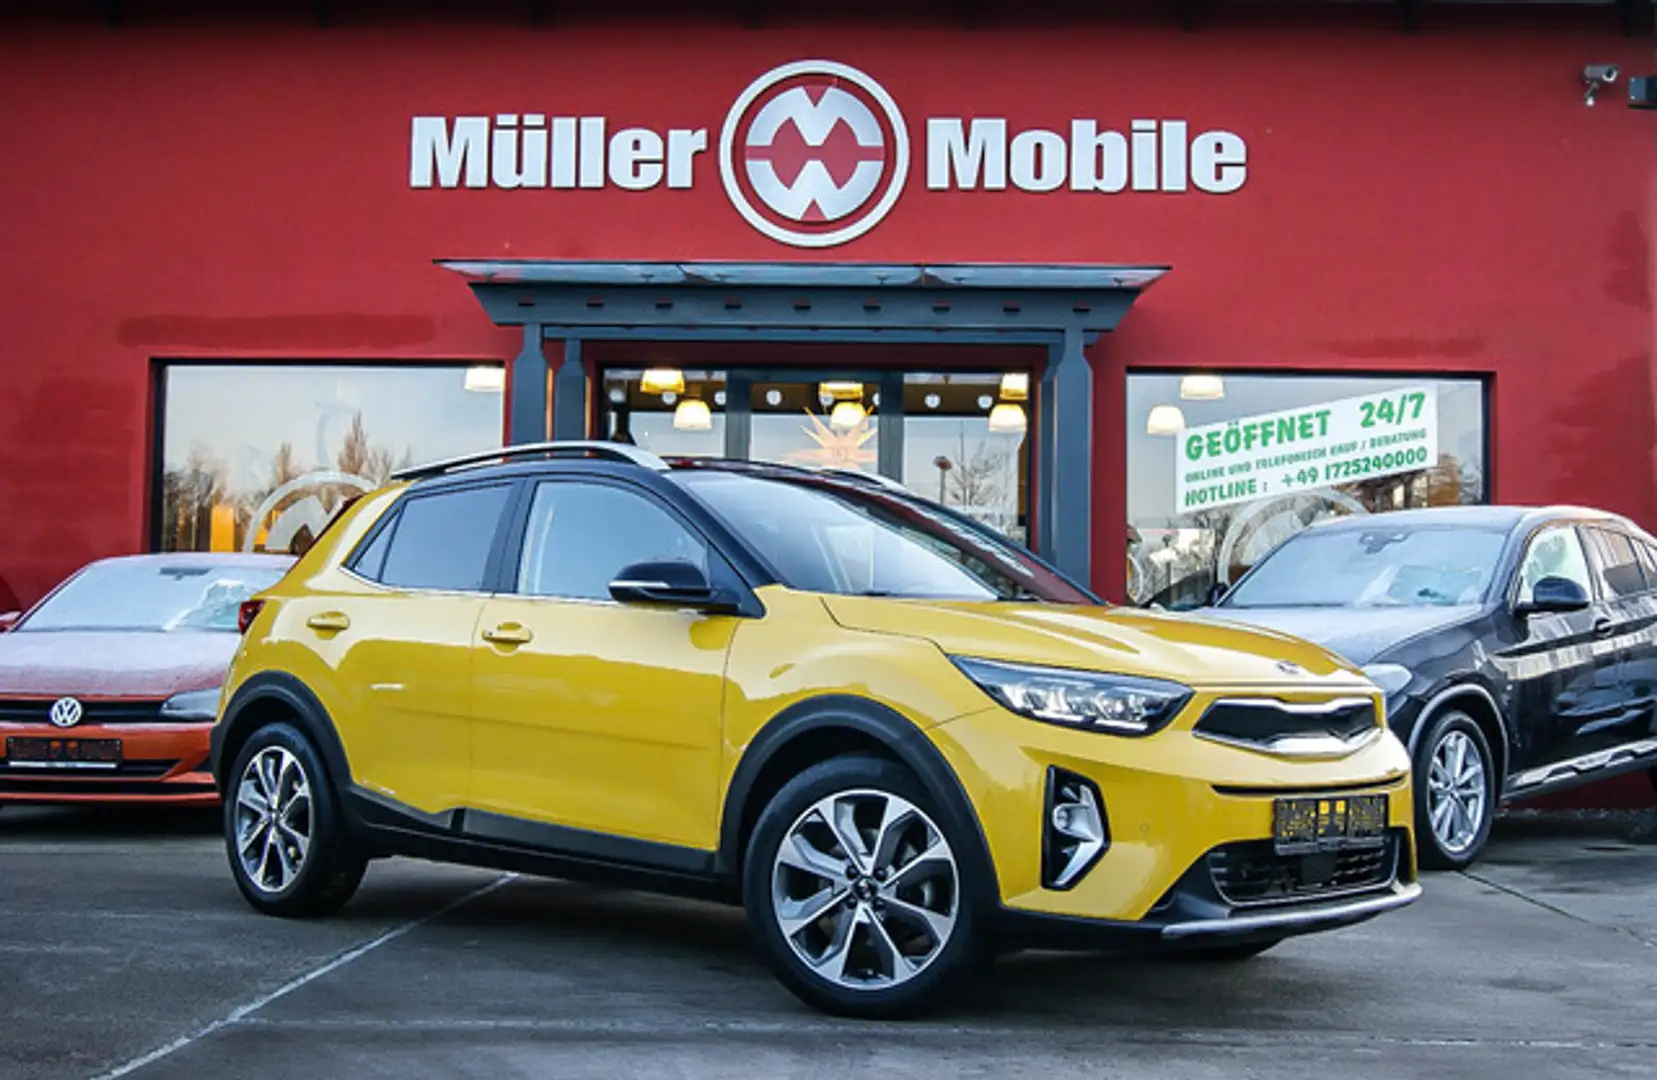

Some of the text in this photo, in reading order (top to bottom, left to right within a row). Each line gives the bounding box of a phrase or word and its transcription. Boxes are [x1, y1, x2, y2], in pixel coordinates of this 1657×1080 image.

[409, 113, 1248, 193] Müller Mobile
[1186, 391, 1426, 461] GEÖFFNET 24/7
[1185, 466, 1226, 484] ONLINE
[1228, 461, 1252, 476] UND
[1185, 479, 1258, 507] HOTLINE
[1324, 446, 1428, 481] 1725240000
